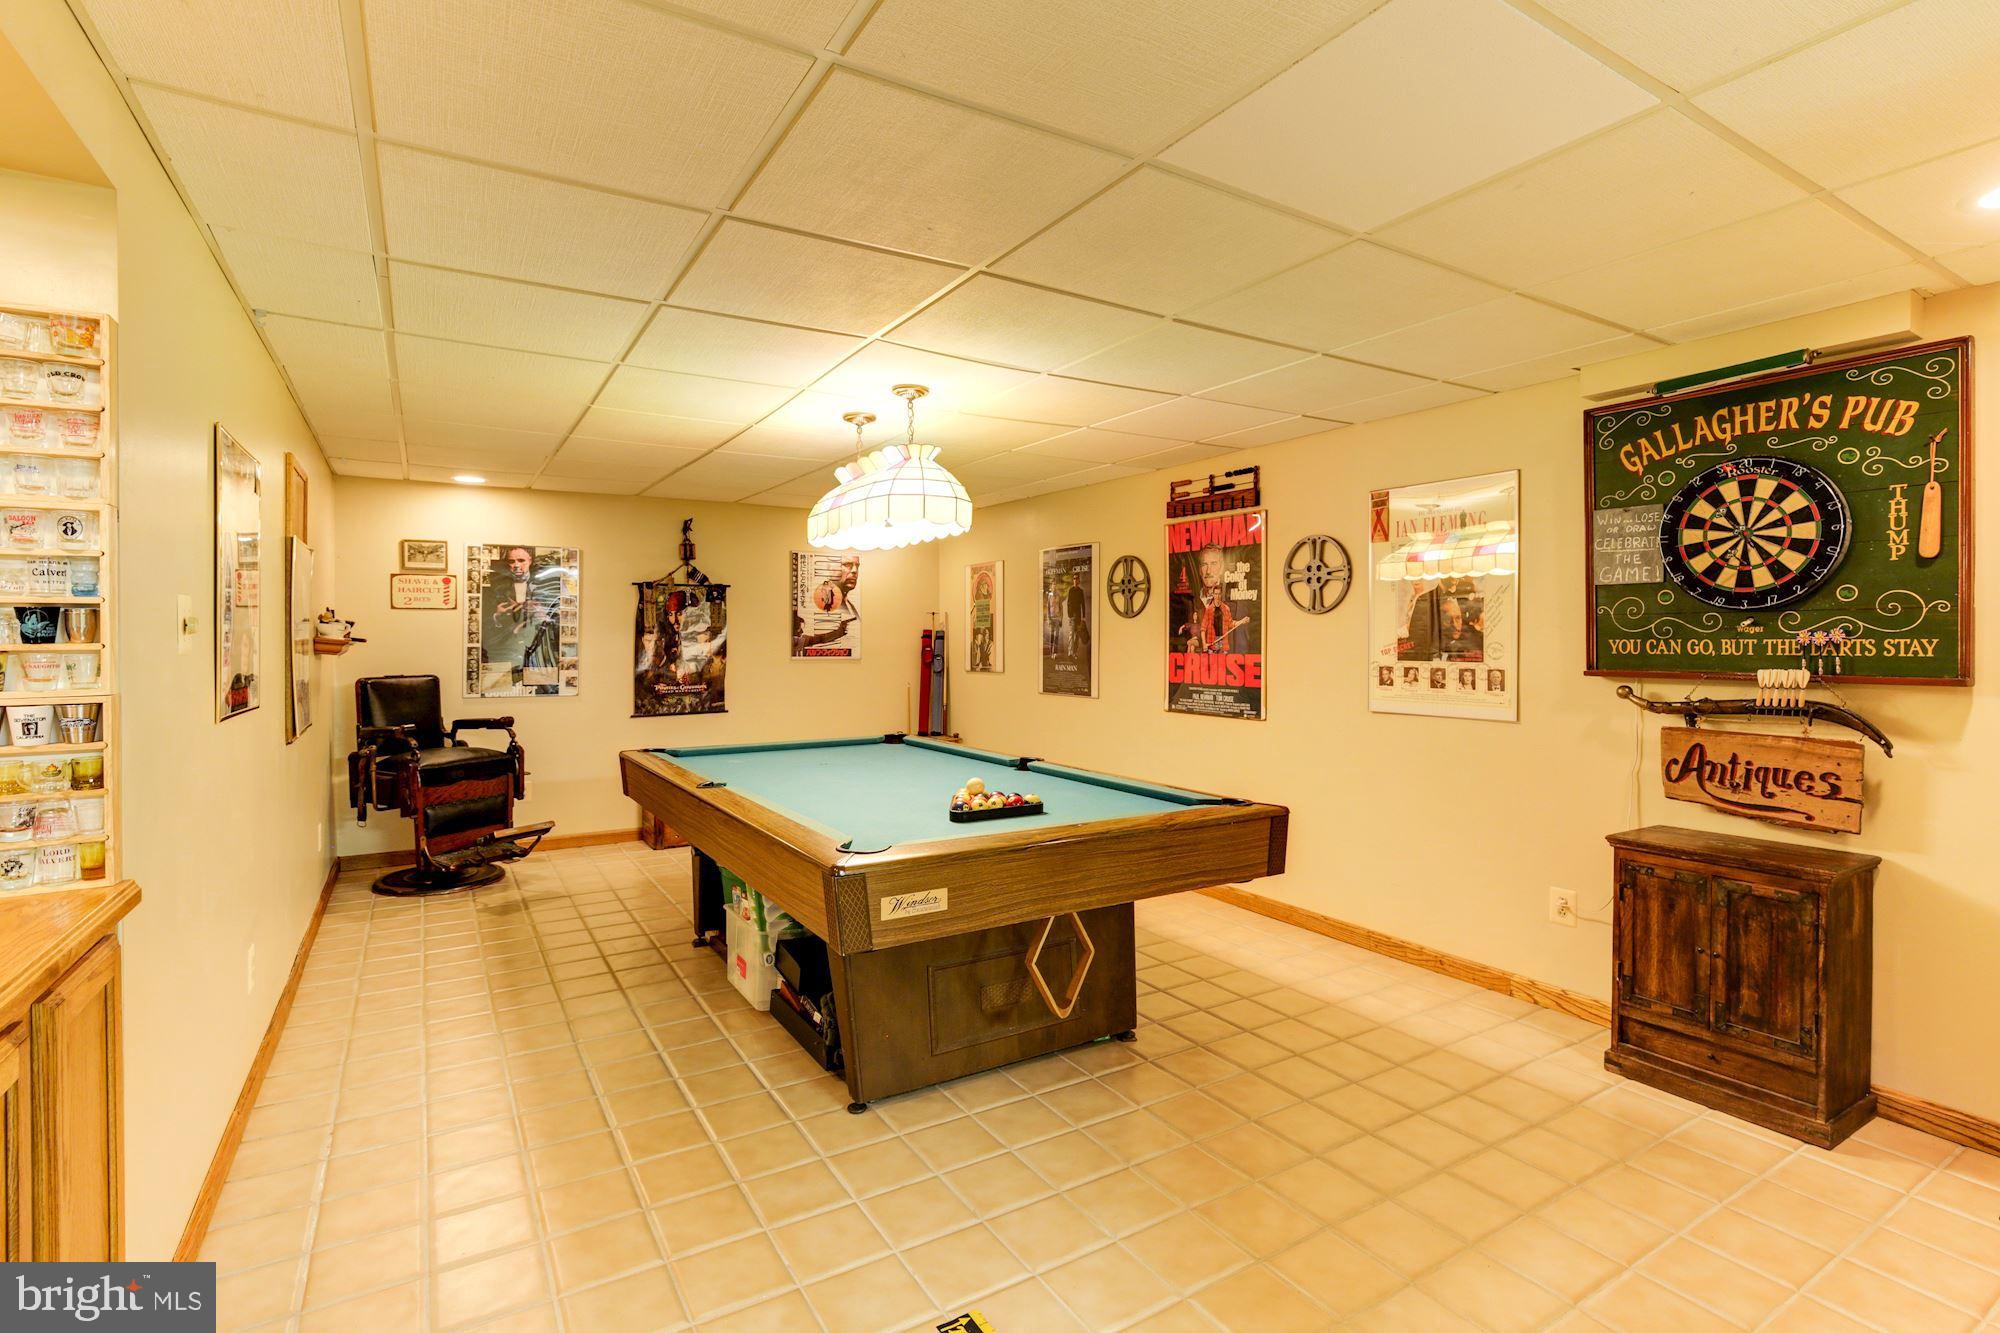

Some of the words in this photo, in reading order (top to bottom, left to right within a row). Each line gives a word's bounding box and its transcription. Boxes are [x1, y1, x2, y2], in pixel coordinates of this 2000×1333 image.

[1620, 393, 1832, 474] GALLAGHER'S
[1839, 395, 1920, 437] PUB
[1726, 466, 1779, 478] Rooster
[1635, 512, 1660, 523] LOSE
[1888, 484, 1909, 561] THUMP
[1169, 513, 1262, 554] NEWMAN
[1396, 518, 1417, 538] IAN
[1626, 525, 1657, 533] DRAW
[1616, 554, 1642, 564] THE
[32, 567, 67, 577] Calvert
[1236, 561, 1251, 573] the
[1224, 570, 1246, 583] Color
[1600, 565, 1660, 583] GAME!
[1238, 579, 1247, 591] of
[404, 596, 412, 605] 2
[1230, 587, 1258, 601] Money
[1608, 639, 1642, 656] YOU
[1646, 639, 1682, 655] CAN
[1687, 639, 1716, 658] GO,
[1721, 639, 1757, 655] BUT
[1763, 639, 1803, 656] THE
[1883, 639, 1939, 657] STAY
[1169, 652, 1262, 688] CRUISE
[1665, 742, 1845, 804] Antiques
